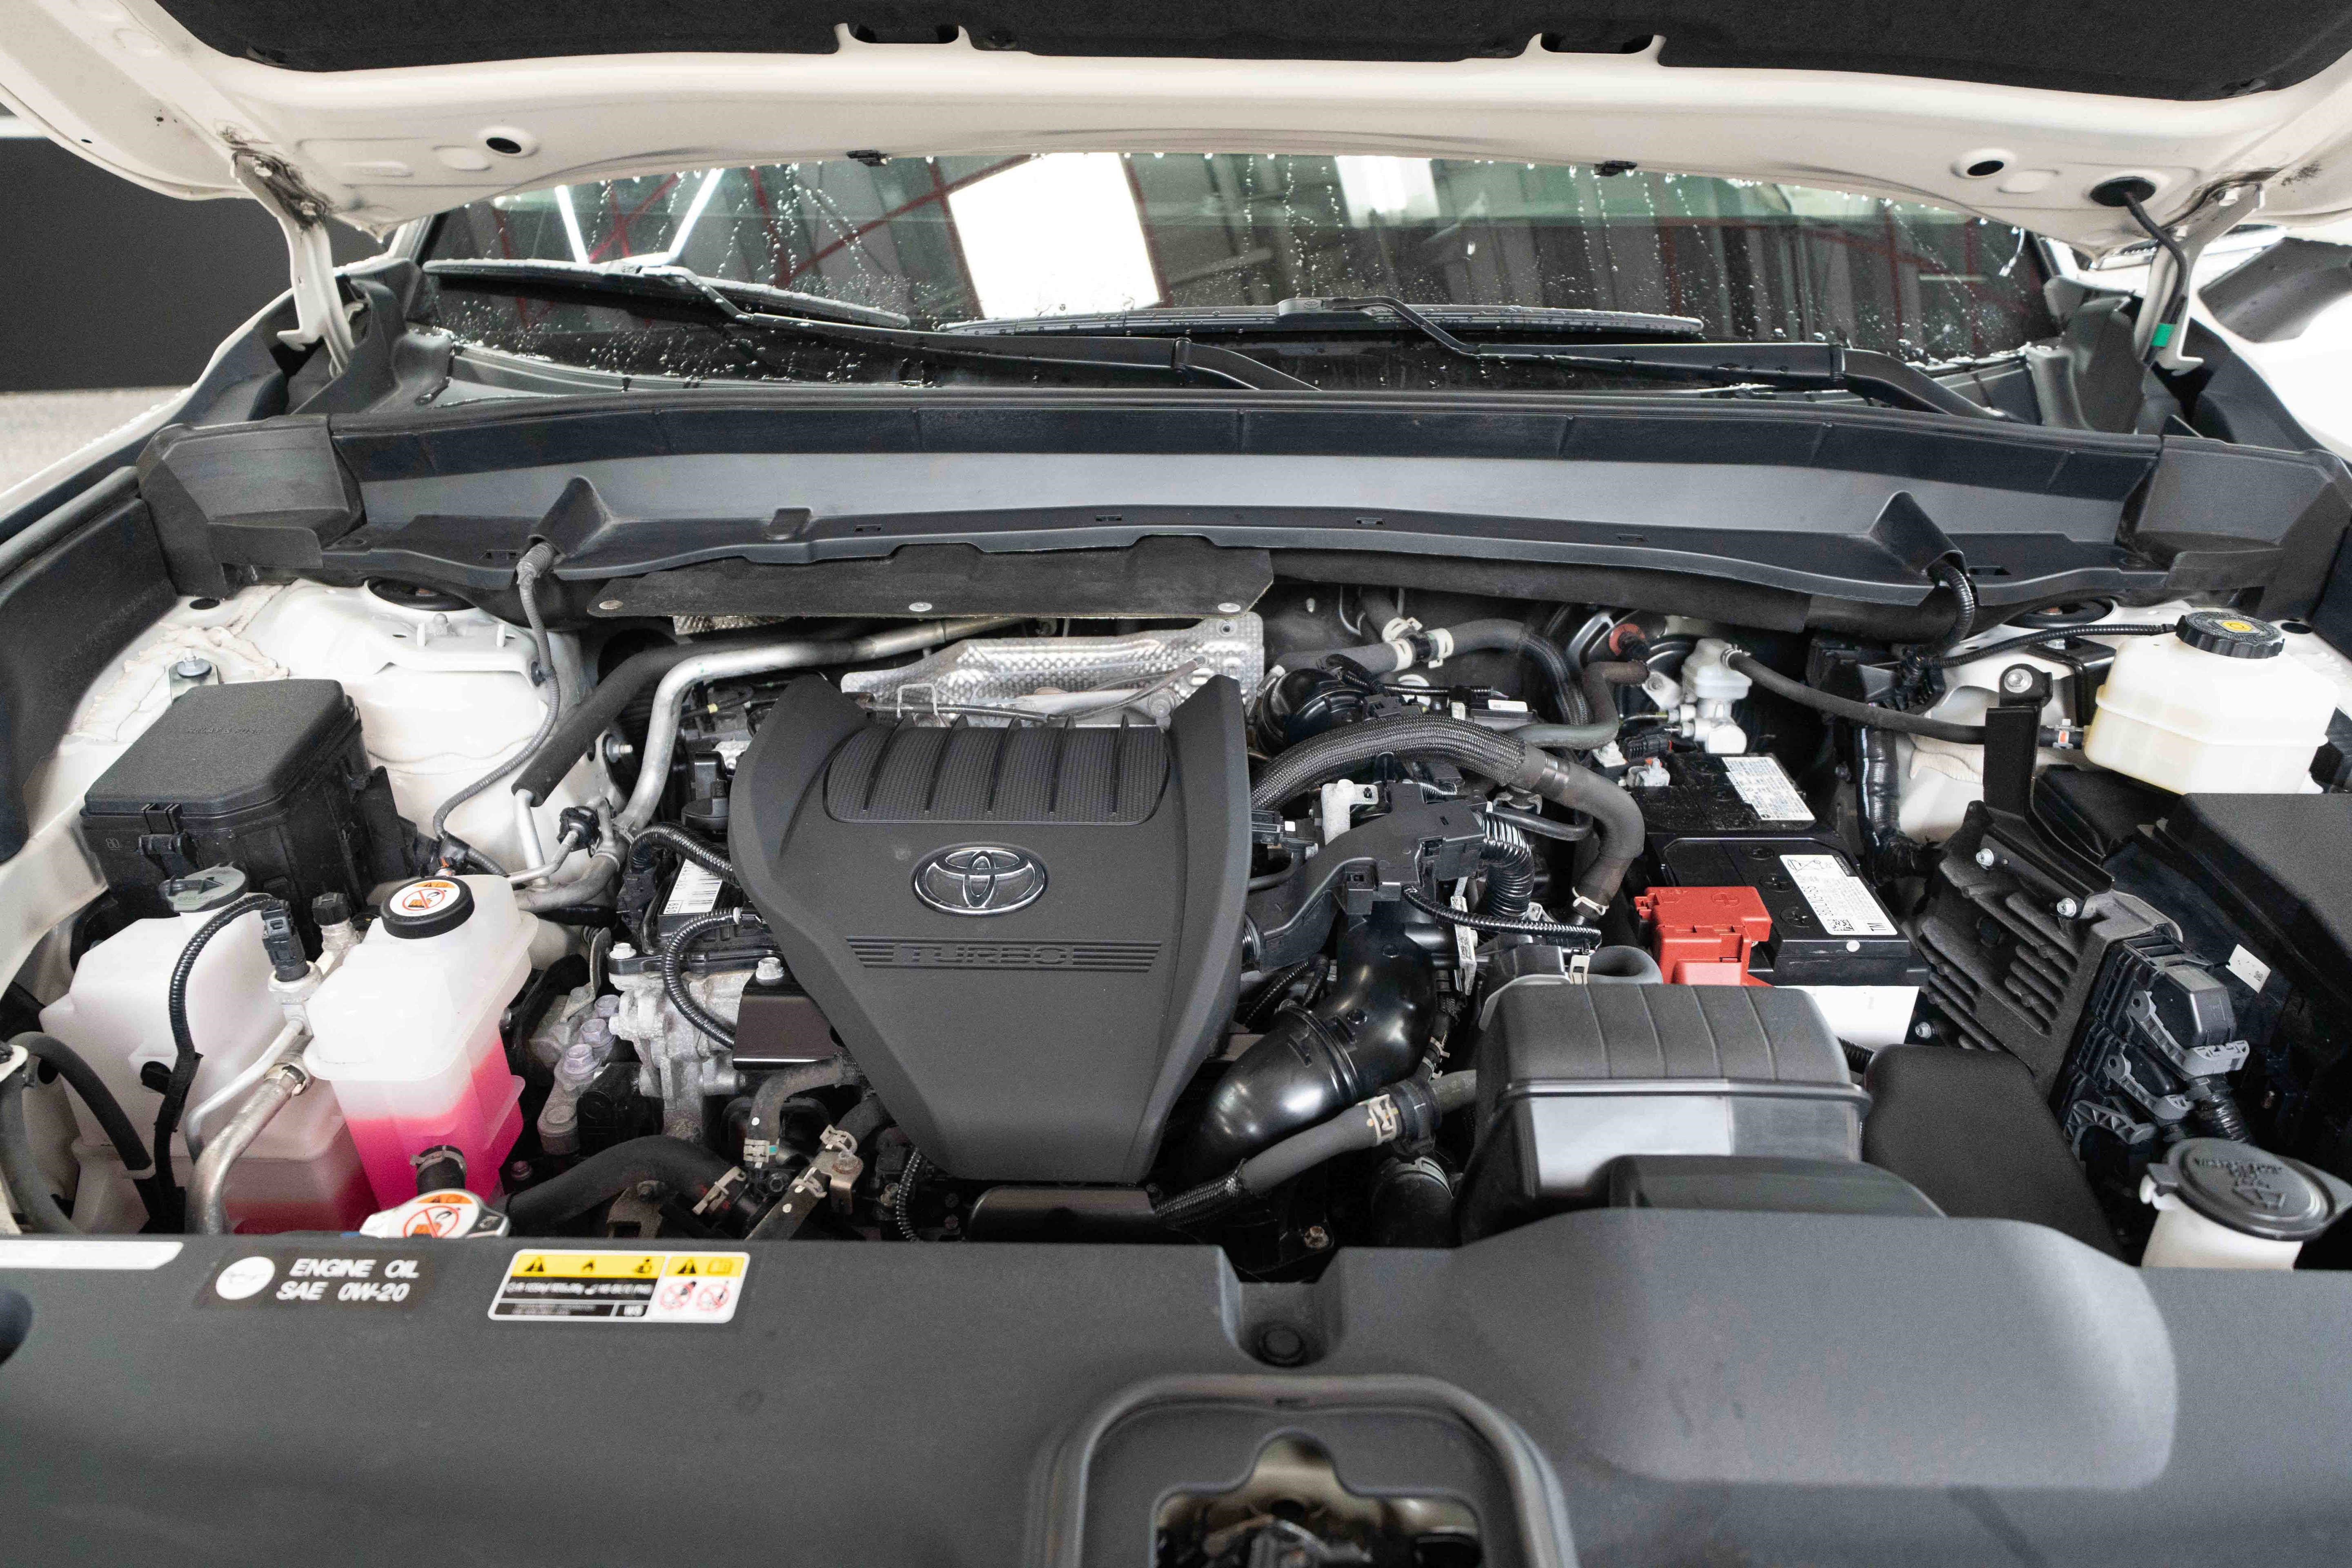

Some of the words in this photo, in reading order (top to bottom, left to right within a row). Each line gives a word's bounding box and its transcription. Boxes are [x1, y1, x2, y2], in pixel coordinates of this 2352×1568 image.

[1867, 922, 1888, 931] TM
[900, 944, 1067, 964] TURBO
[289, 1258, 377, 1277] ENGINE
[384, 1260, 420, 1278] OIL
[276, 1280, 329, 1300] SAE
[337, 1282, 410, 1302] 0W-20
